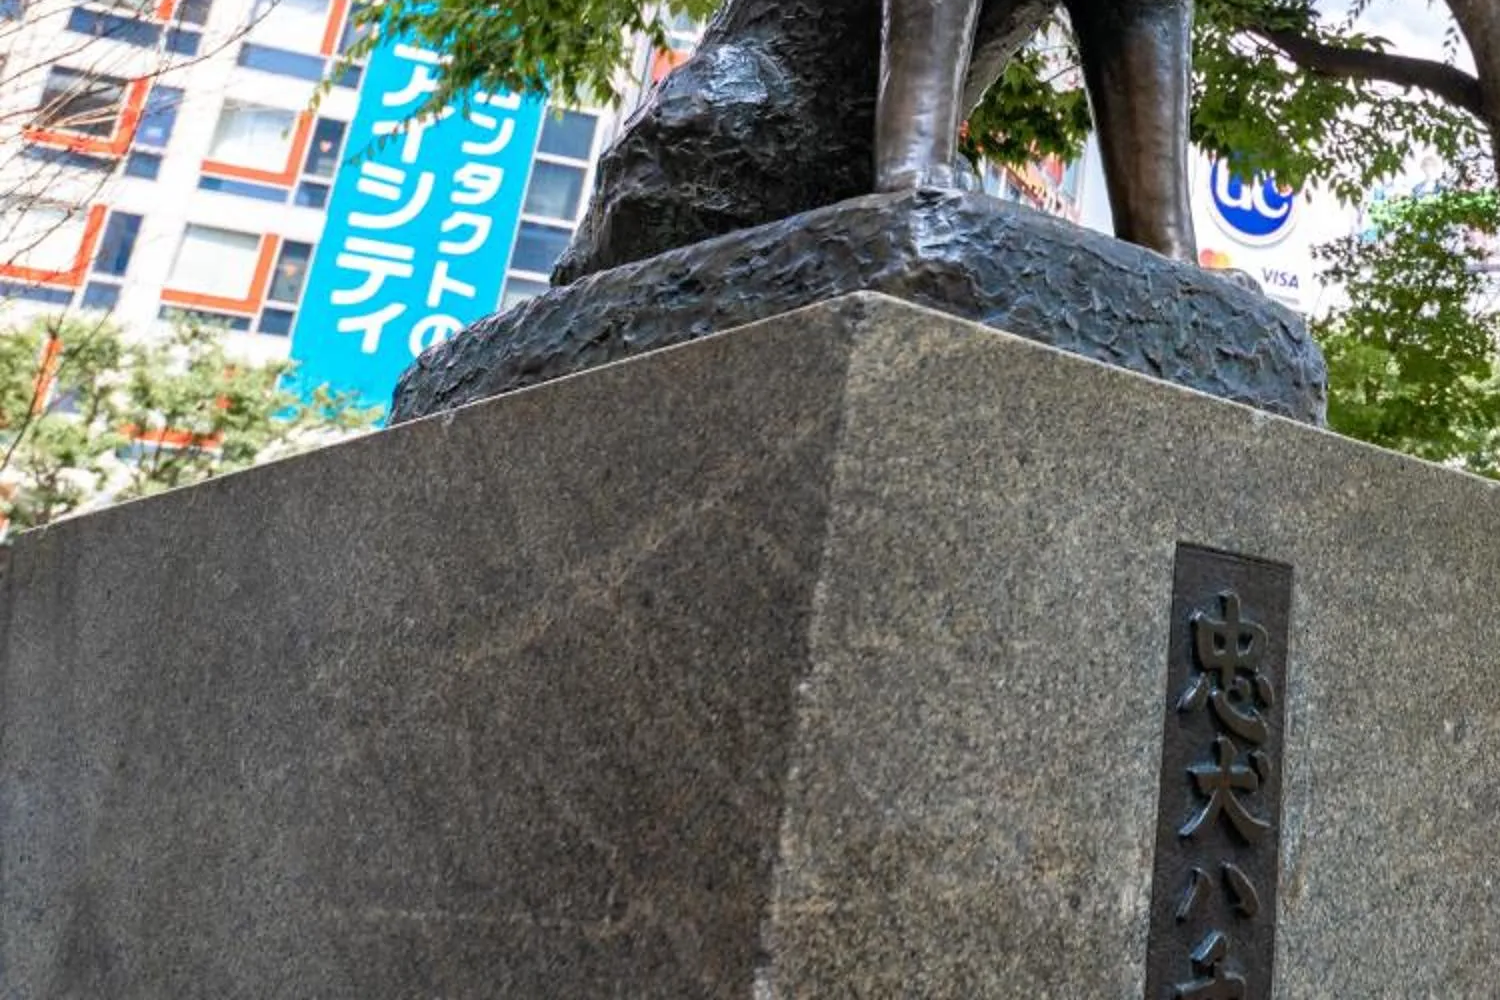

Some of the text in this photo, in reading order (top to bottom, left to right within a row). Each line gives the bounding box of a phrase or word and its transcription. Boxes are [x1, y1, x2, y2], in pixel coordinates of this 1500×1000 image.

[330, 43, 455, 354] アイシティ
[1261, 267, 1300, 288] VISA
